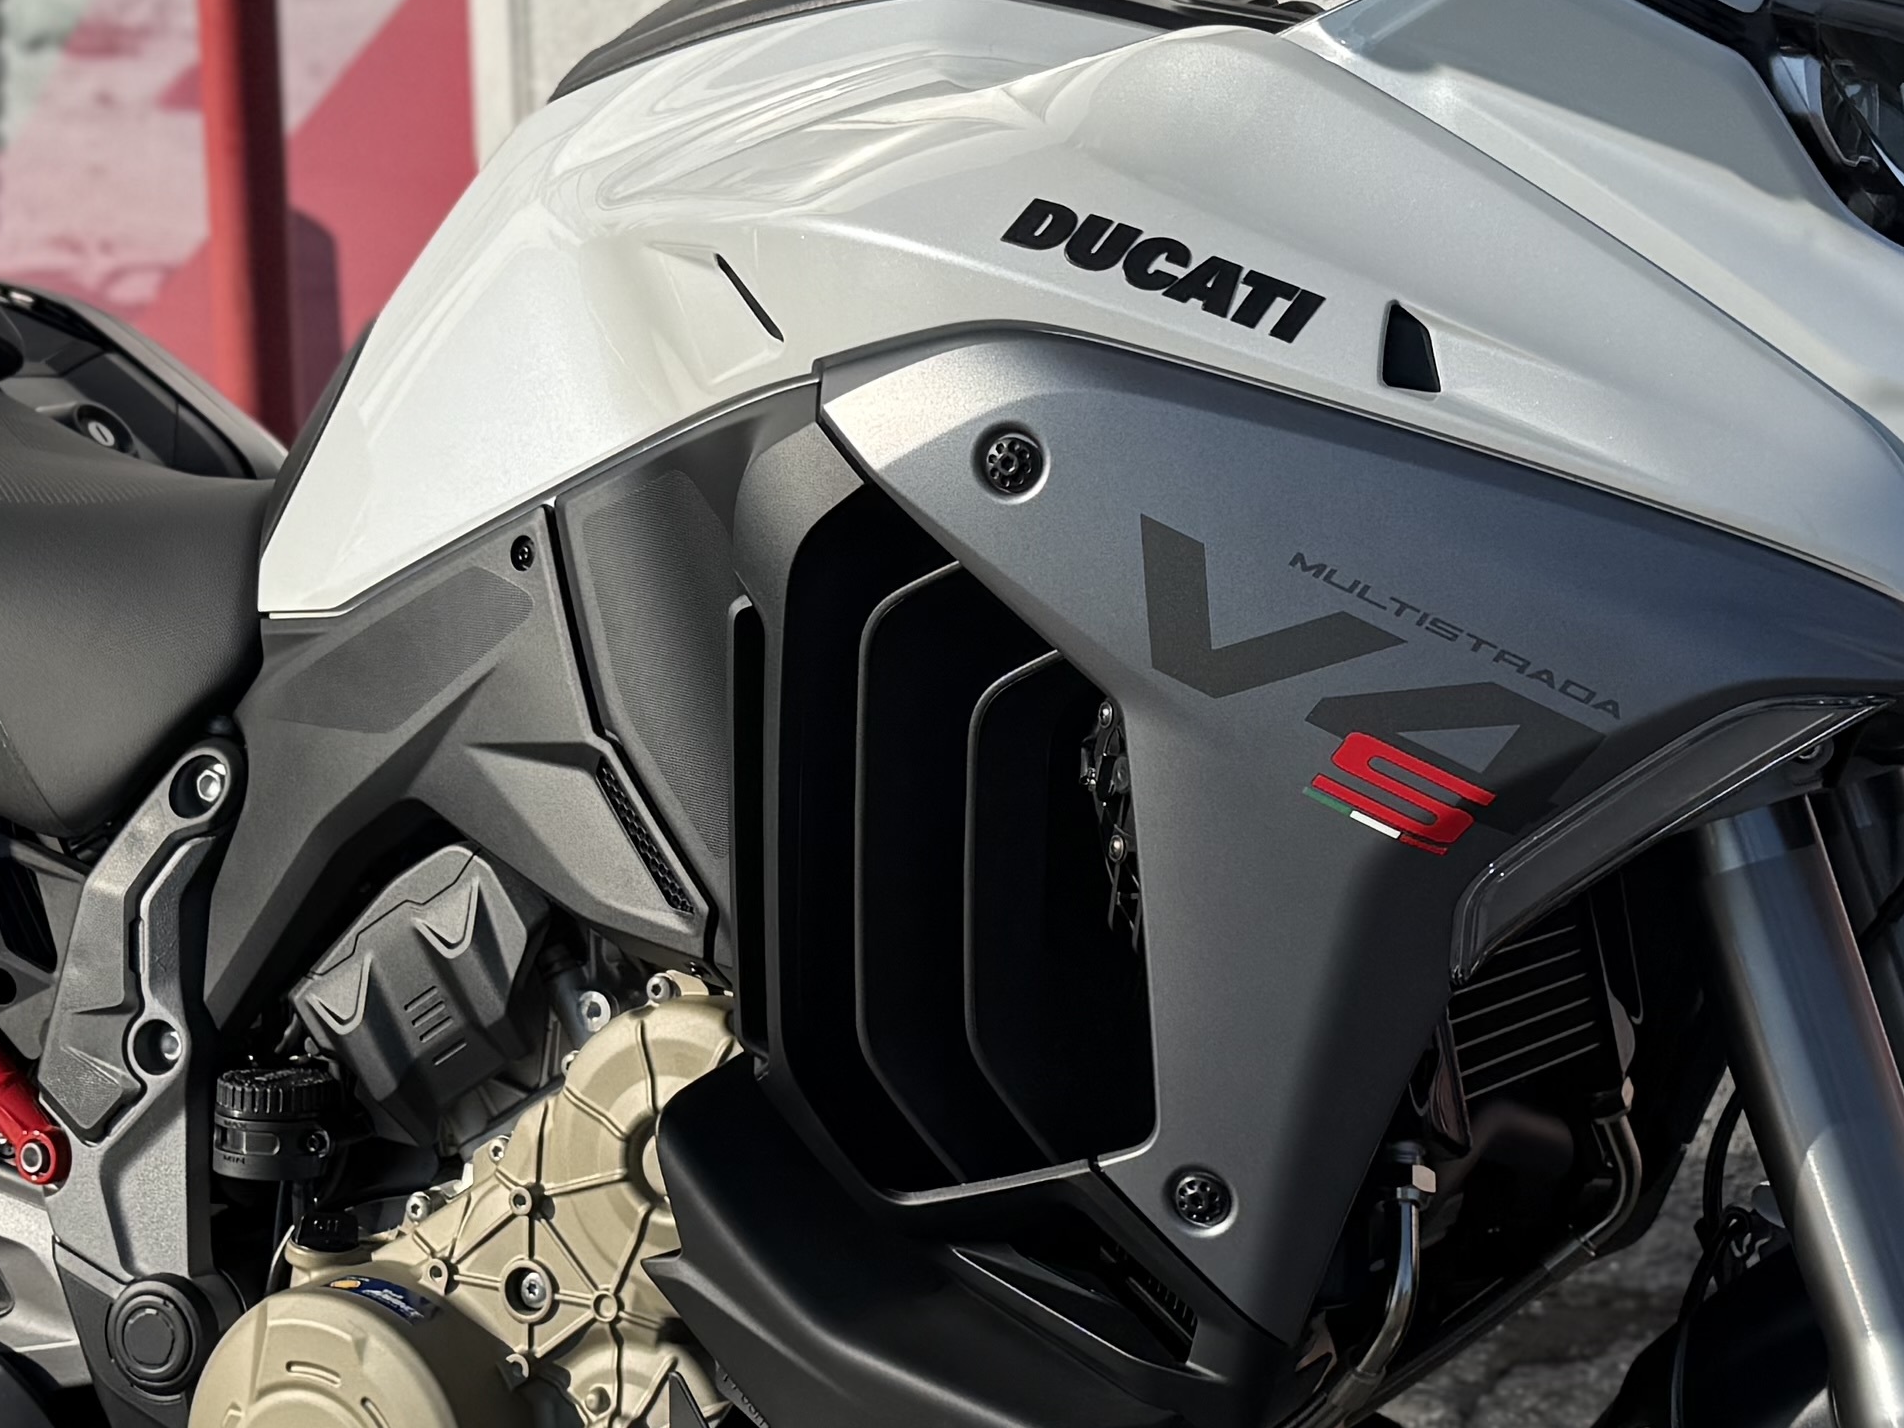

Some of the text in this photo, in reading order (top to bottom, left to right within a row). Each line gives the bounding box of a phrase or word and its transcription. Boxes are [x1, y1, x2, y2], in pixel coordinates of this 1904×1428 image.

[1000, 198, 1327, 344] DUCATI
[1288, 552, 1623, 721] MULTISTRADA
[1311, 731, 1498, 844] S
